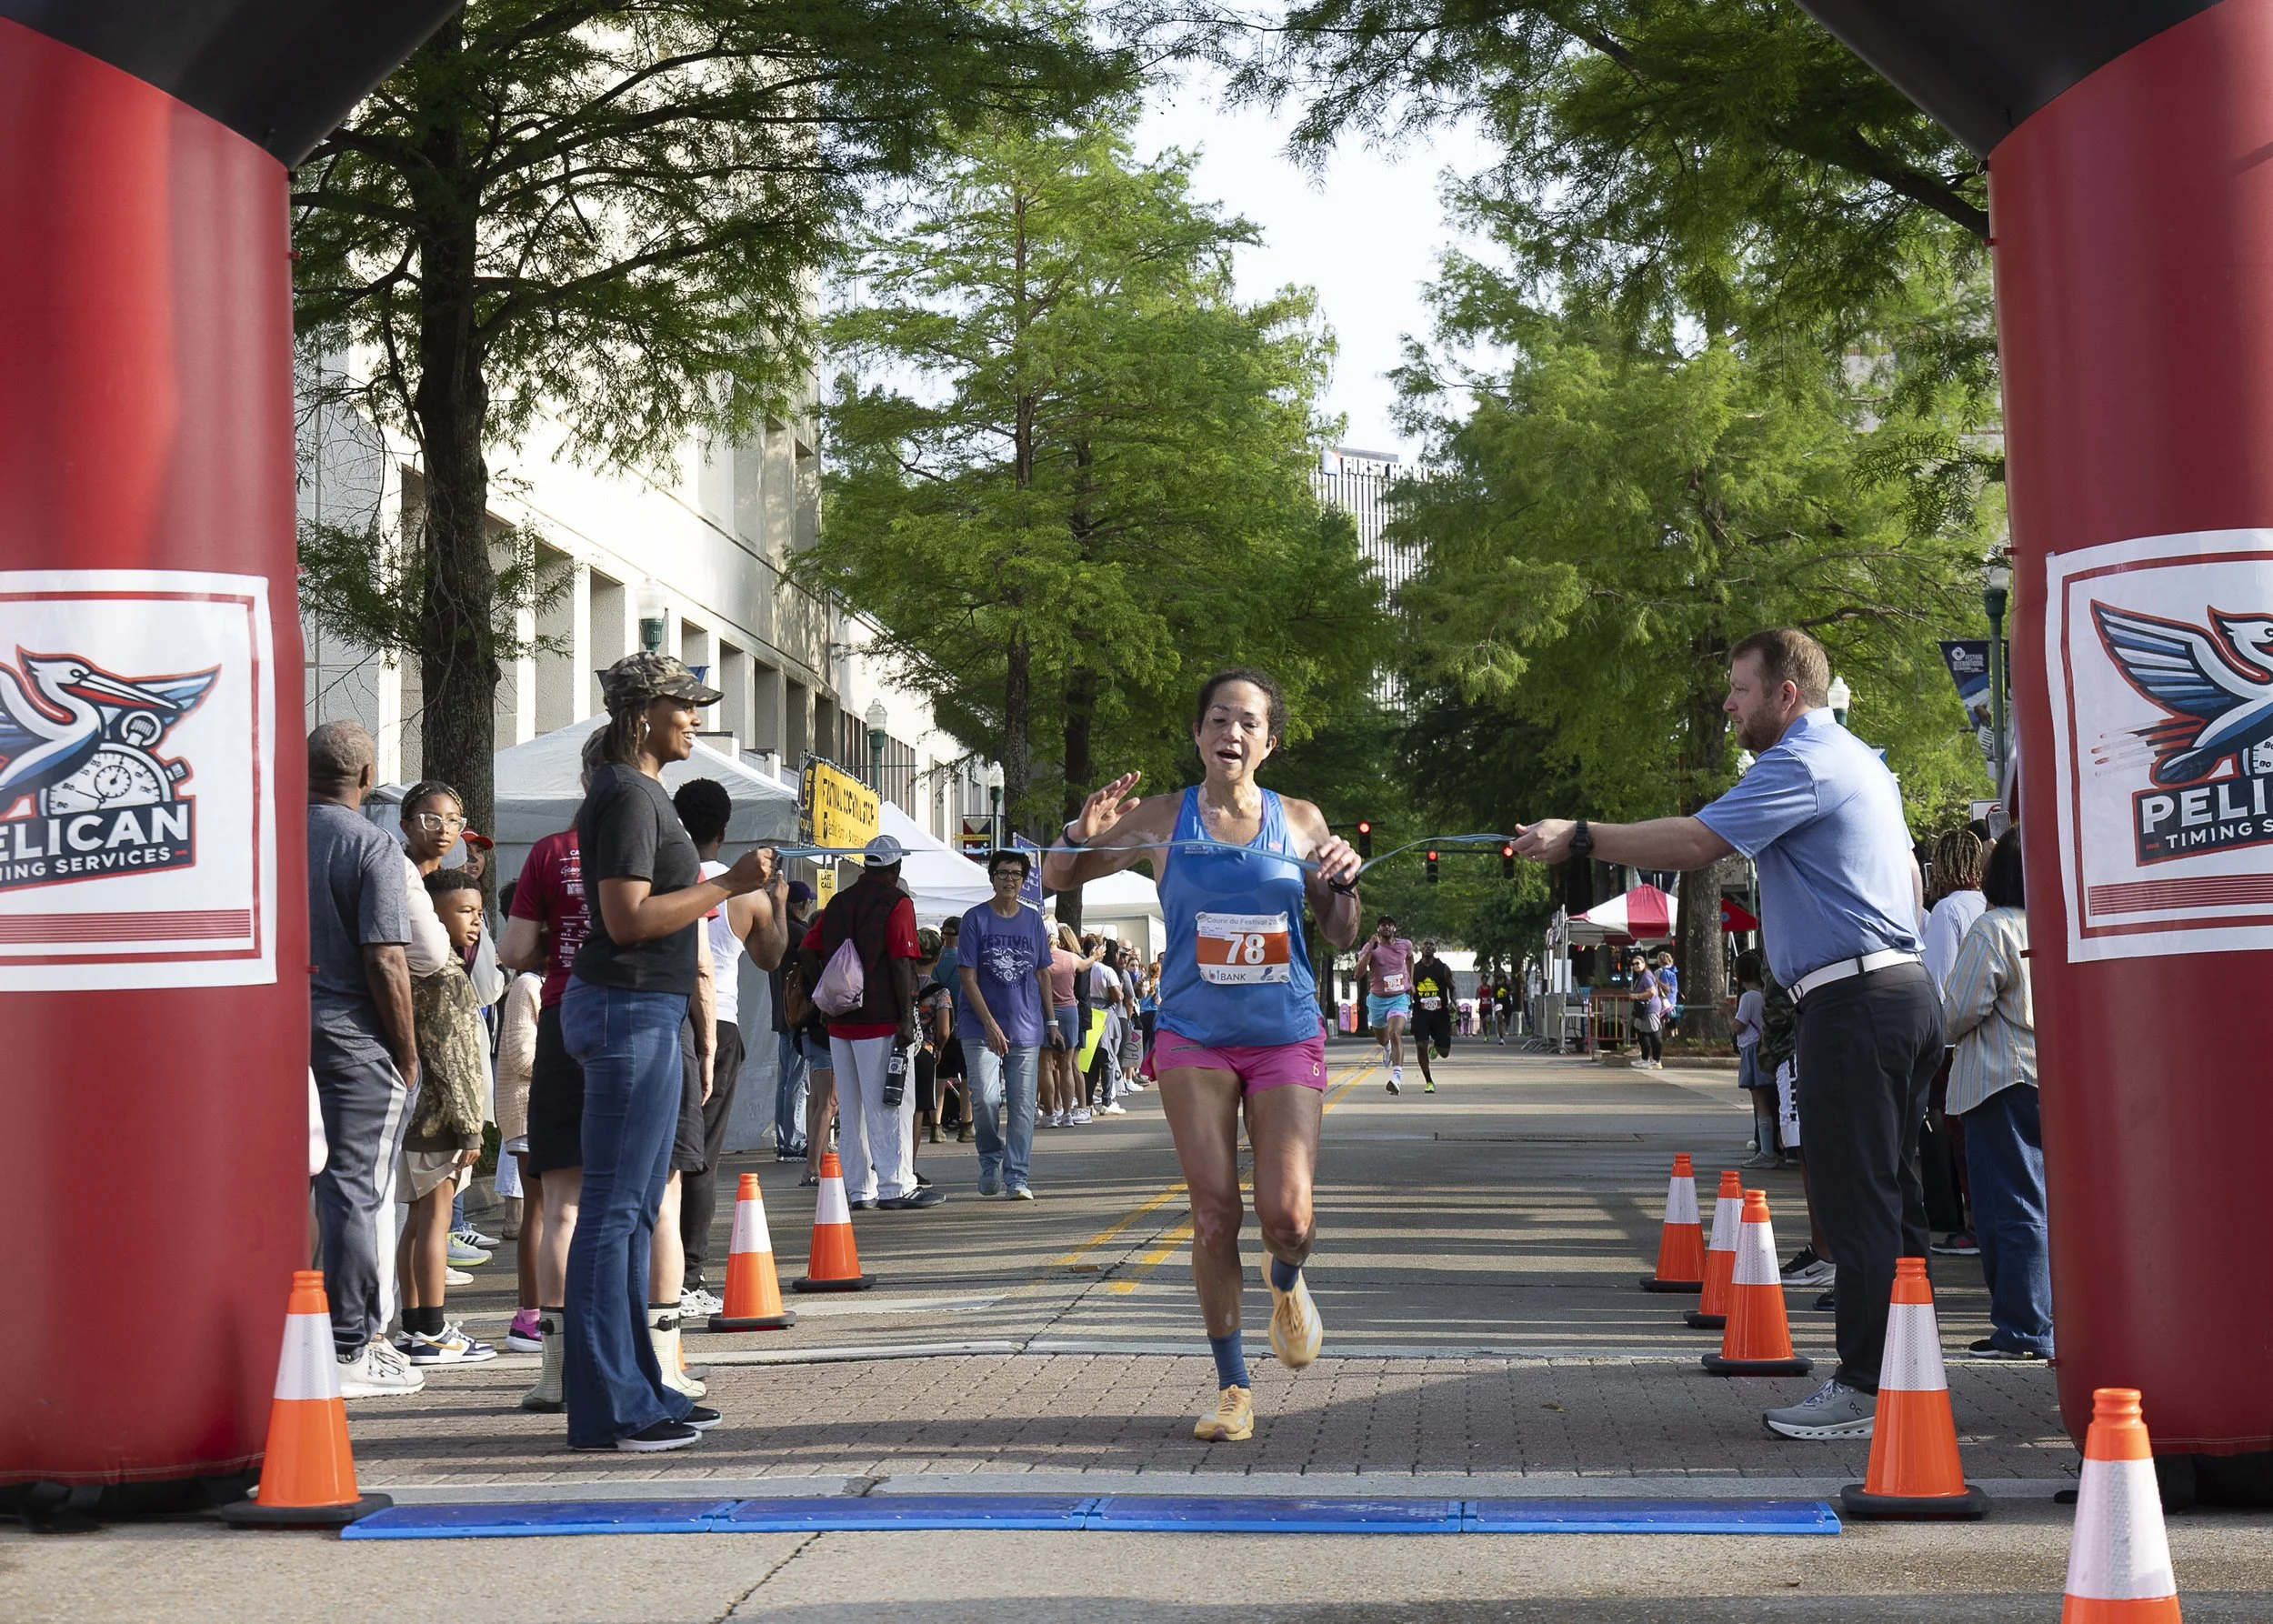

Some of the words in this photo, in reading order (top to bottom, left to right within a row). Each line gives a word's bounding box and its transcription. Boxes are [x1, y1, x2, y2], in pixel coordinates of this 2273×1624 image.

[1343, 457, 1387, 477] FIRST
[2140, 777, 2273, 835] PELI
[2165, 822, 2253, 849] TIMING
[55, 847, 171, 874] SERVICES
[1239, 917, 1267, 926] Festival
[980, 934, 1035, 952] FESTIVAL
[1224, 933, 1266, 965] 78
